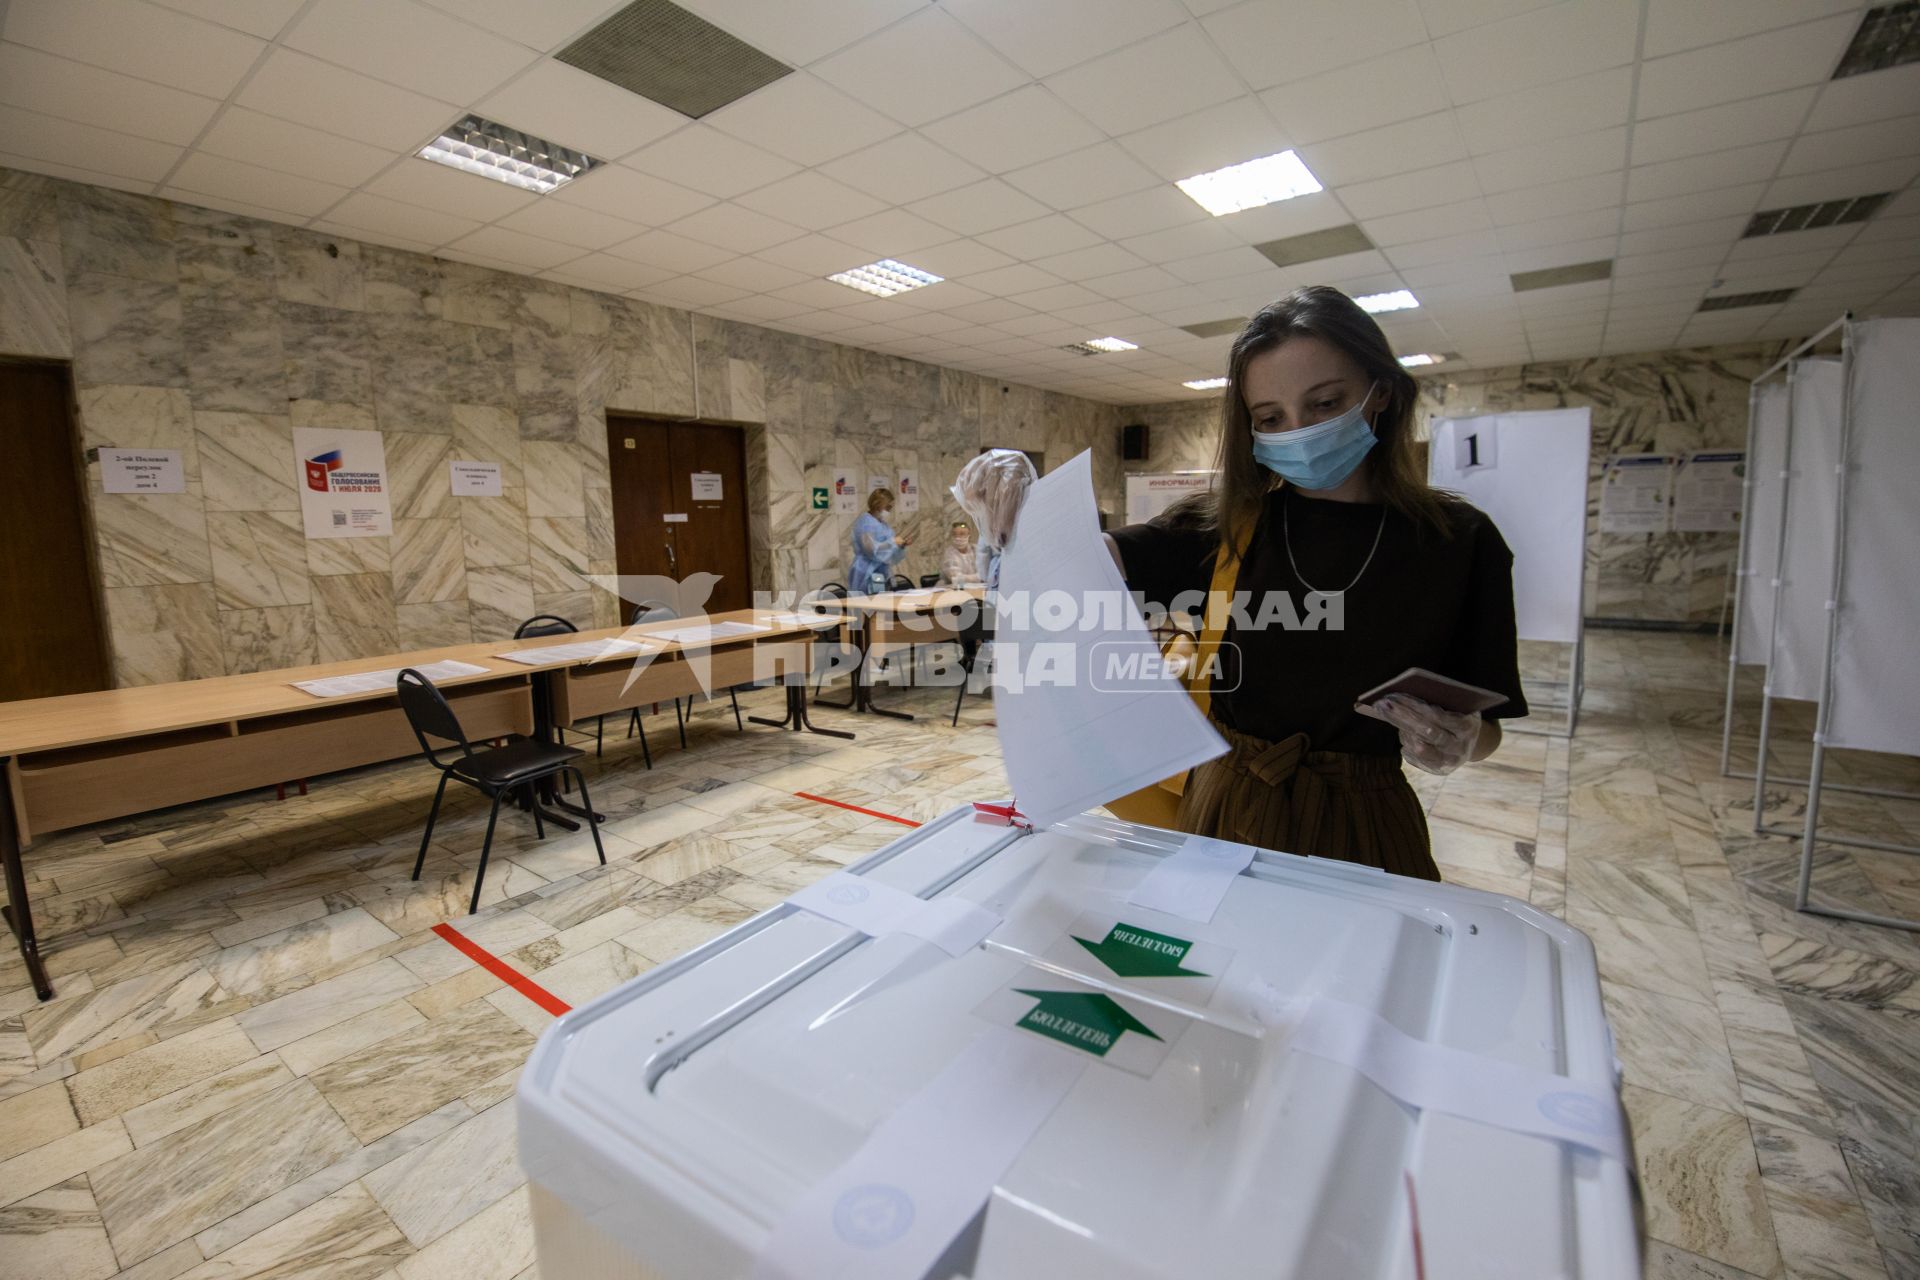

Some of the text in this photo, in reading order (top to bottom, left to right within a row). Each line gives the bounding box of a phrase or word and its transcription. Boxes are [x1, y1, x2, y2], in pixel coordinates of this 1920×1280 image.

[1464, 433, 1484, 467] 1
[331, 478, 381, 486] ГОЛОСОВАНИЕ
[1149, 479, 1206, 487] ИНФОРМАЦИЯ
[1113, 929, 1185, 958] БЮЛЛЕТЕНЬ
[1028, 1009, 1111, 1047] БЮЛЛЕТЕНЬ
